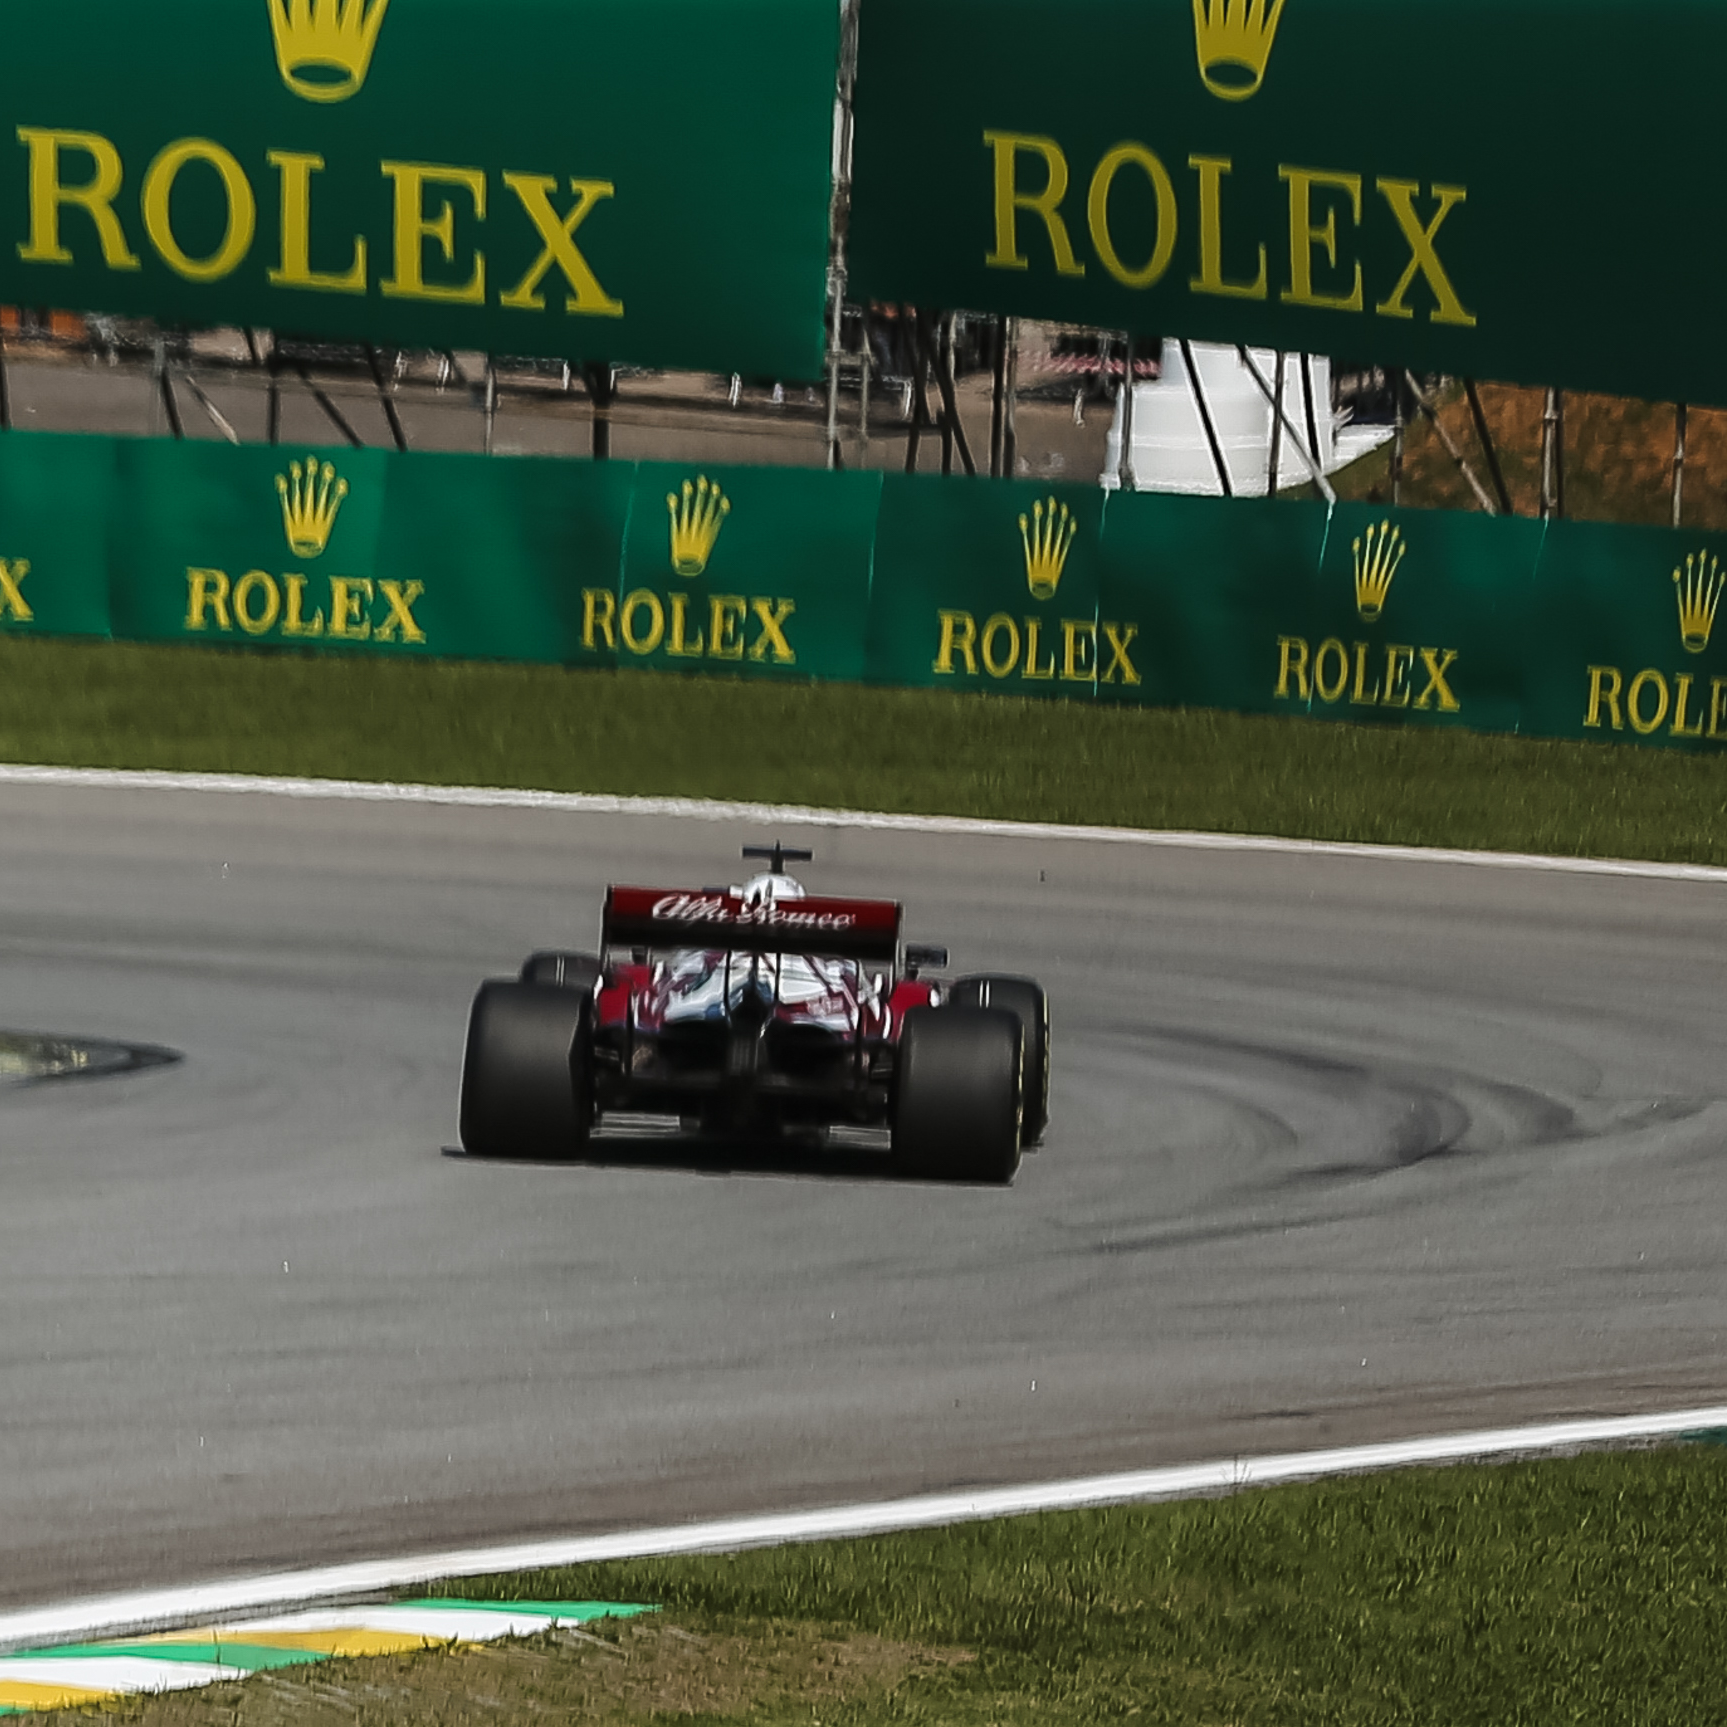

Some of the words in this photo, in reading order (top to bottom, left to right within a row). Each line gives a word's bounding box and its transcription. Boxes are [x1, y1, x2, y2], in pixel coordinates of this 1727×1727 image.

[16, 125, 624, 319] ROLEX
[983, 129, 1477, 328] ROLEX
[183, 566, 427, 644] ROLEX
[580, 587, 796, 664] ROLEX
[934, 609, 1141, 686] ROLEX
[1274, 635, 1460, 713] ROLEX
